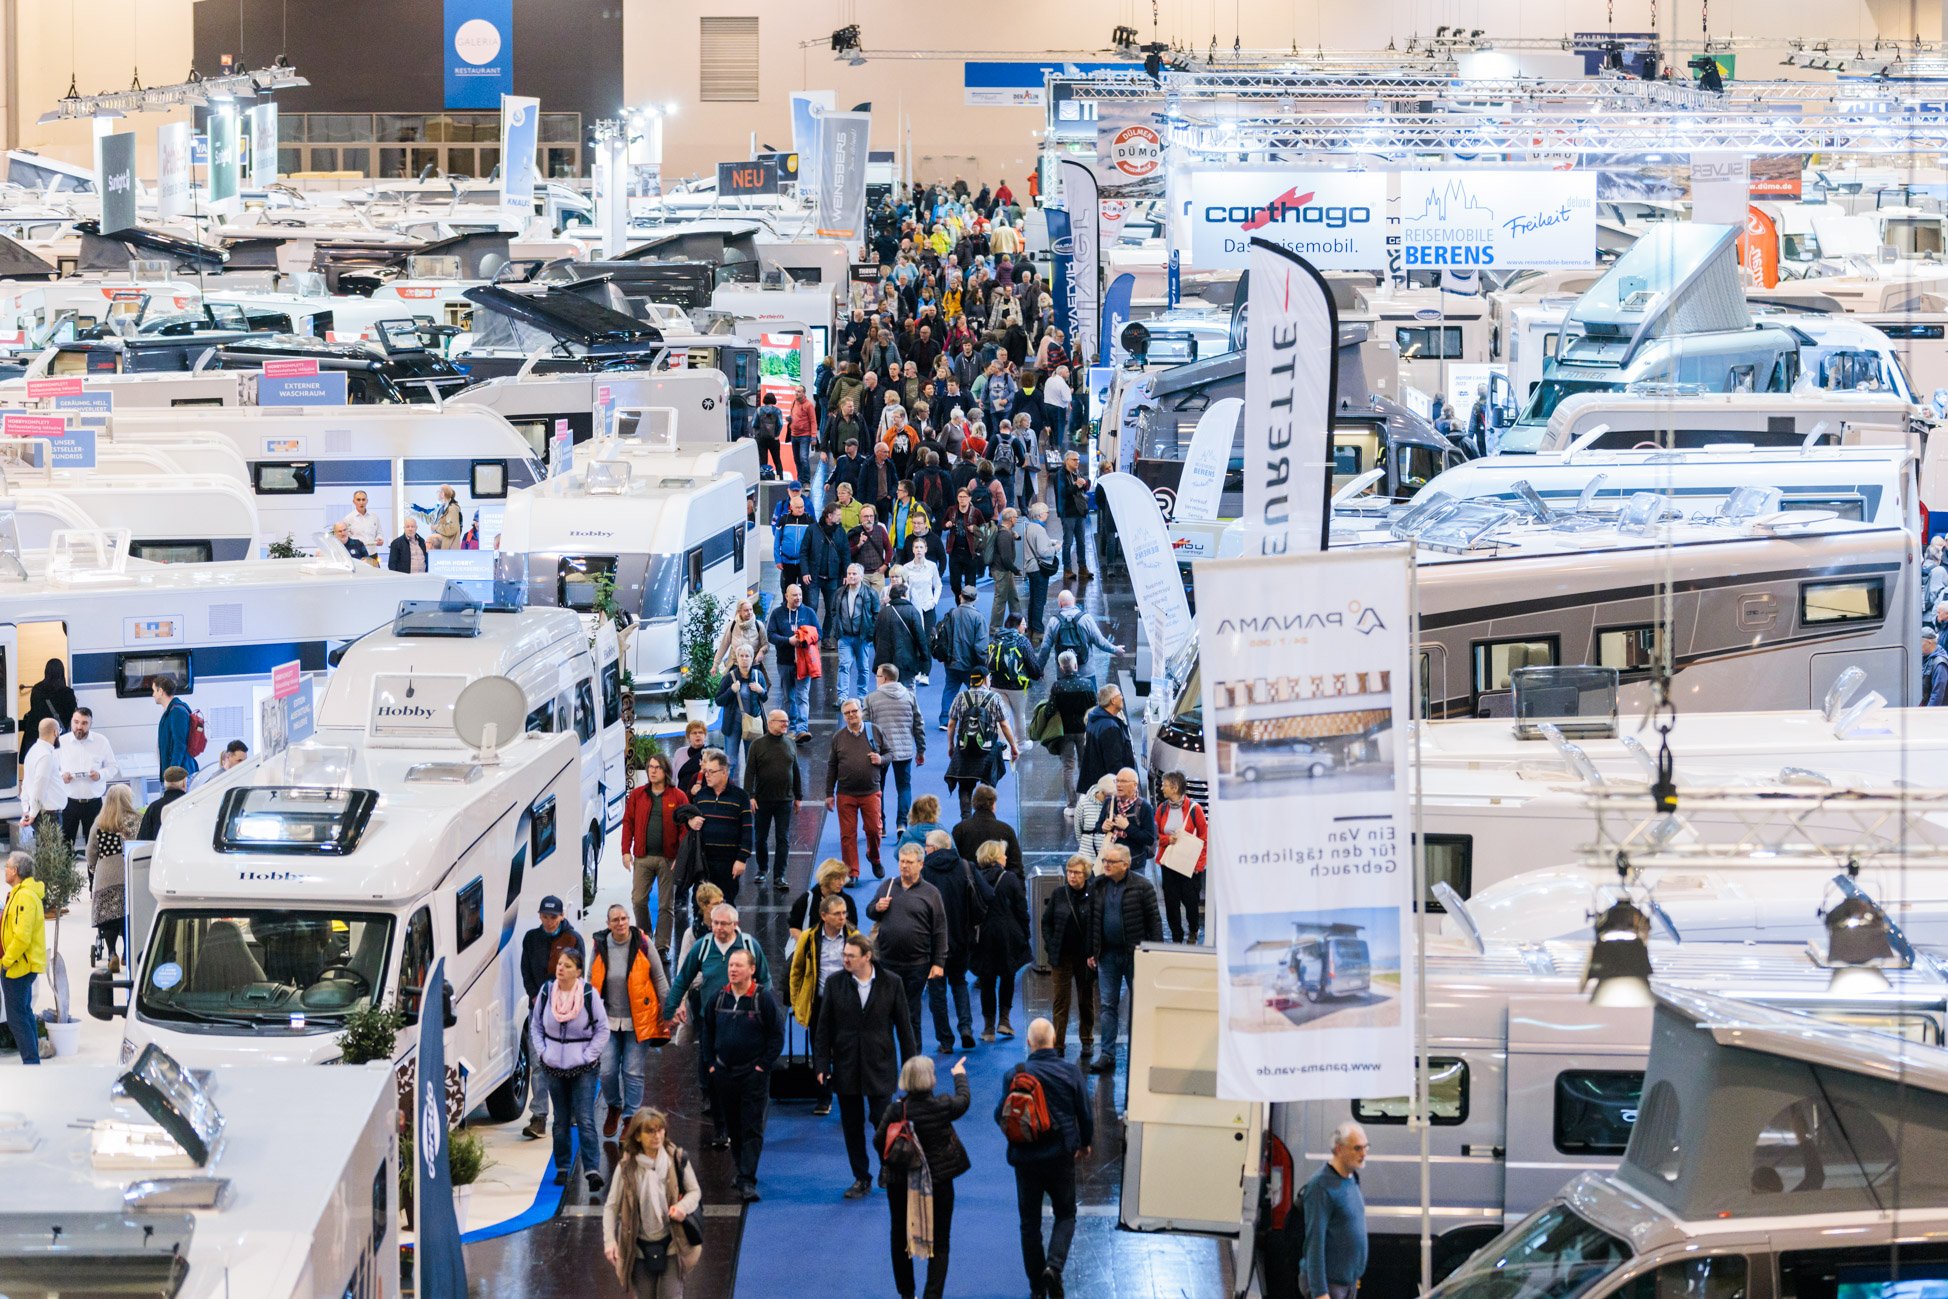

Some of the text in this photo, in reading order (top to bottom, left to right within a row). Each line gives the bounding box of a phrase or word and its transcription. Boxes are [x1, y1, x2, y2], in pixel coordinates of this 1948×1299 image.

[1122, 128, 1153, 139] DÜLMEN
[1118, 145, 1158, 157] DÜMO
[732, 168, 765, 189] NEU
[832, 132, 847, 222] WEINSBERG
[1566, 197, 1591, 208] deluxe
[1205, 201, 1371, 228] carthago
[1502, 205, 1571, 238] Freiheit
[1405, 228, 1494, 242] REISEMOBILE
[1224, 238, 1251, 253] Das
[1405, 245, 1495, 265] BERENS
[284, 382, 320, 390] EXTERNER
[569, 530, 614, 538] Hobby
[378, 705, 437, 720] Hobby
